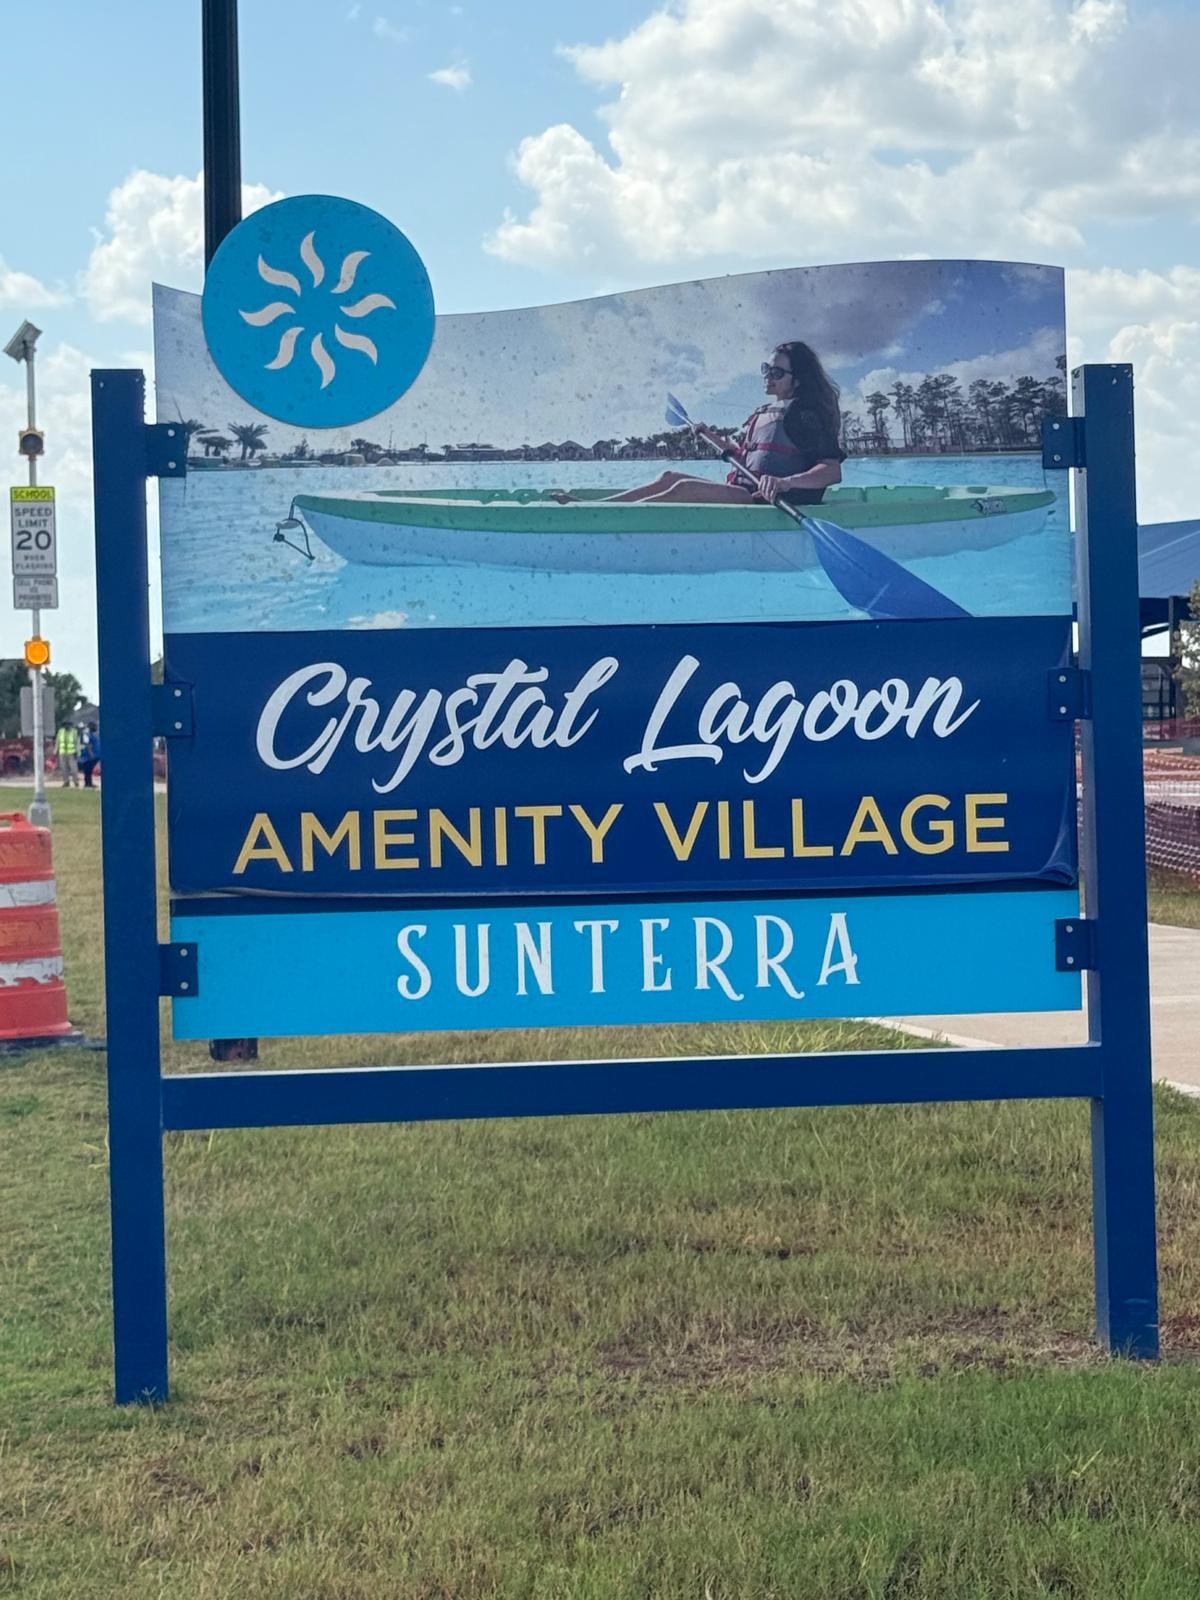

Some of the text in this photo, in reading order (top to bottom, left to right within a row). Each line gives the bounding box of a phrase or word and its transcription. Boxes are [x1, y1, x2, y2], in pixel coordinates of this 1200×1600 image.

[13, 490, 53, 500] SCHOOL
[14, 507, 53, 517] SPEED
[18, 518, 48, 528] LIMIT
[16, 530, 52, 551] 20
[256, 654, 981, 794] Crystal Lagoon
[232, 793, 1010, 875] AMENITY VILLAGE
[396, 912, 860, 1001] SUNTERRA
